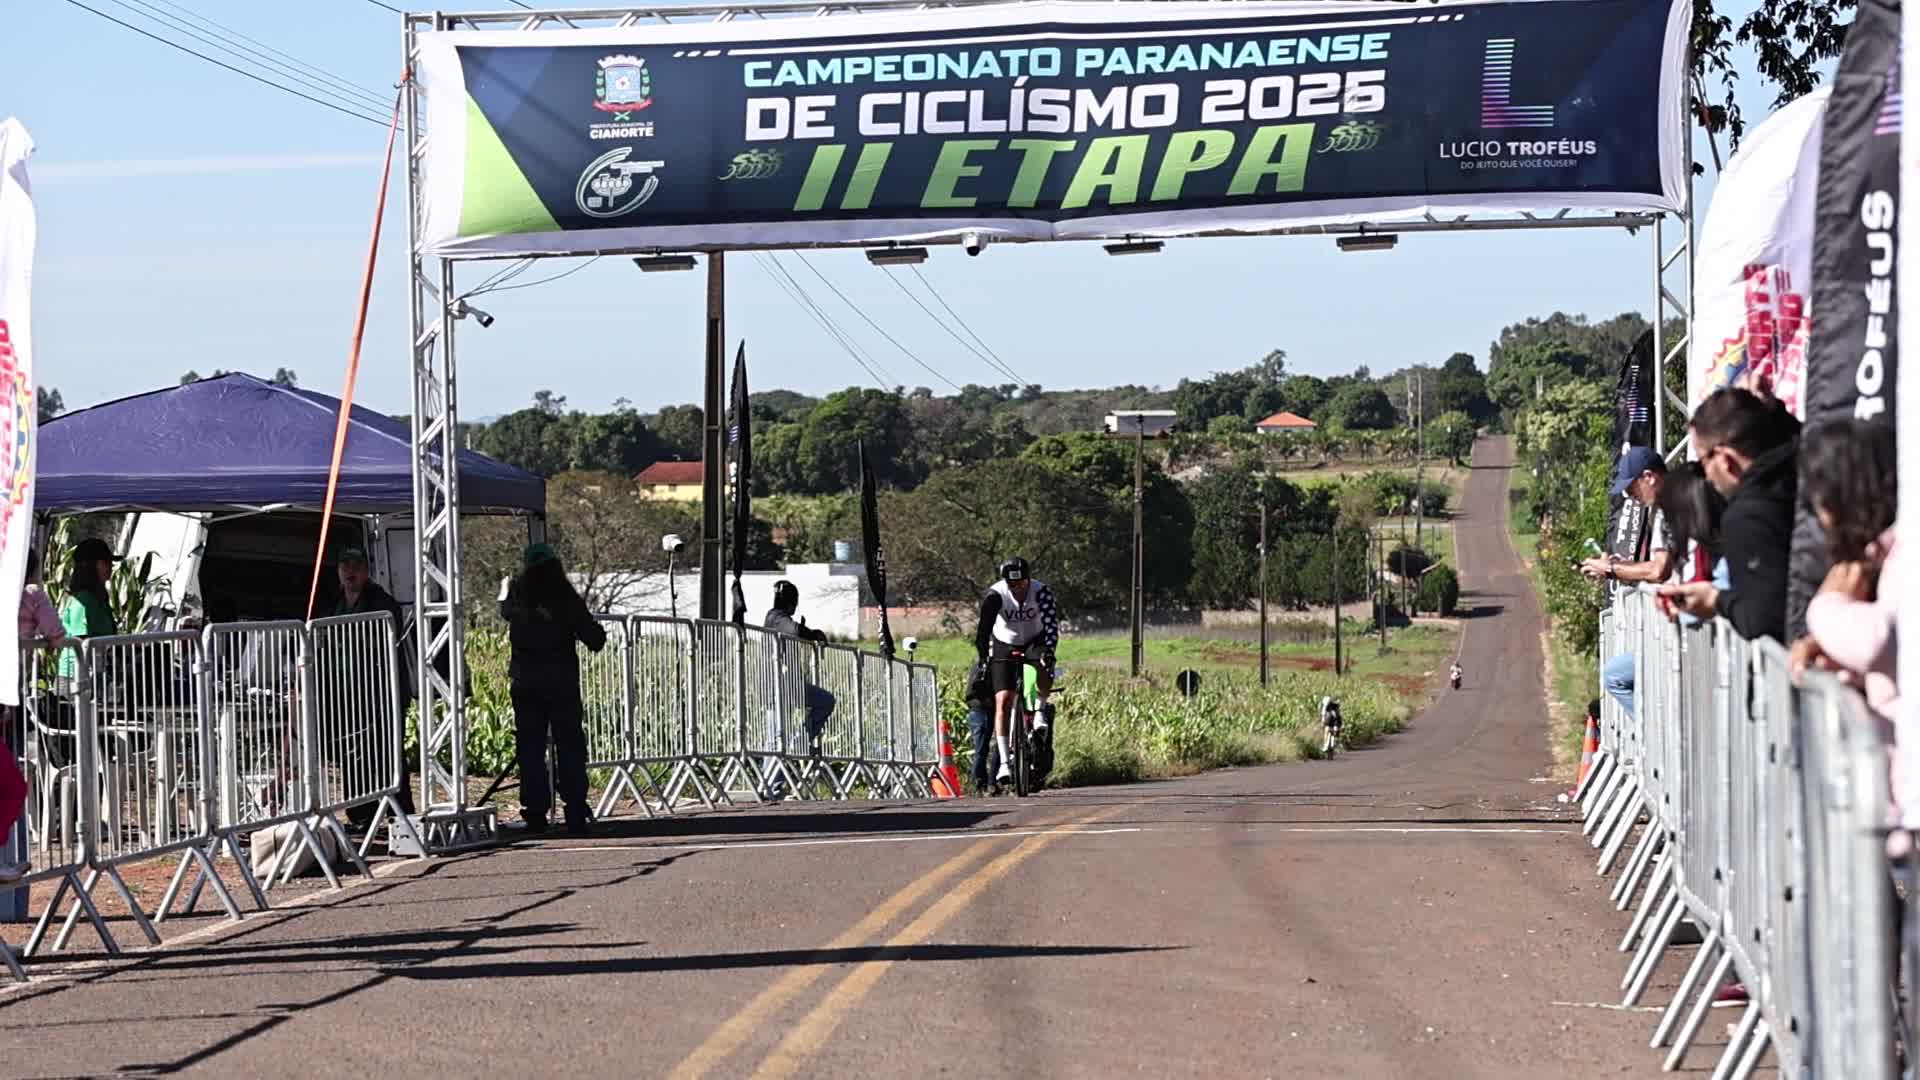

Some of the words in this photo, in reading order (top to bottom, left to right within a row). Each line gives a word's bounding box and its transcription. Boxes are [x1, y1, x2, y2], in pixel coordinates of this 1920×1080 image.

[744, 47, 1061, 88] CAMPEONATO
[1075, 32, 1391, 78] PARANAENSE
[745, 94, 837, 141] DE
[858, 75, 1180, 136] CICLÍSMO
[1200, 69, 1386, 124] 2025
[590, 127, 654, 139] CIANORTE
[1439, 141, 1501, 158] LUCIO
[1506, 137, 1597, 156] TROFÉUS
[793, 142, 894, 211] II
[920, 122, 1316, 210] ETAPA
[1460, 161, 1474, 169] DO
[1499, 160, 1519, 169] QUE
